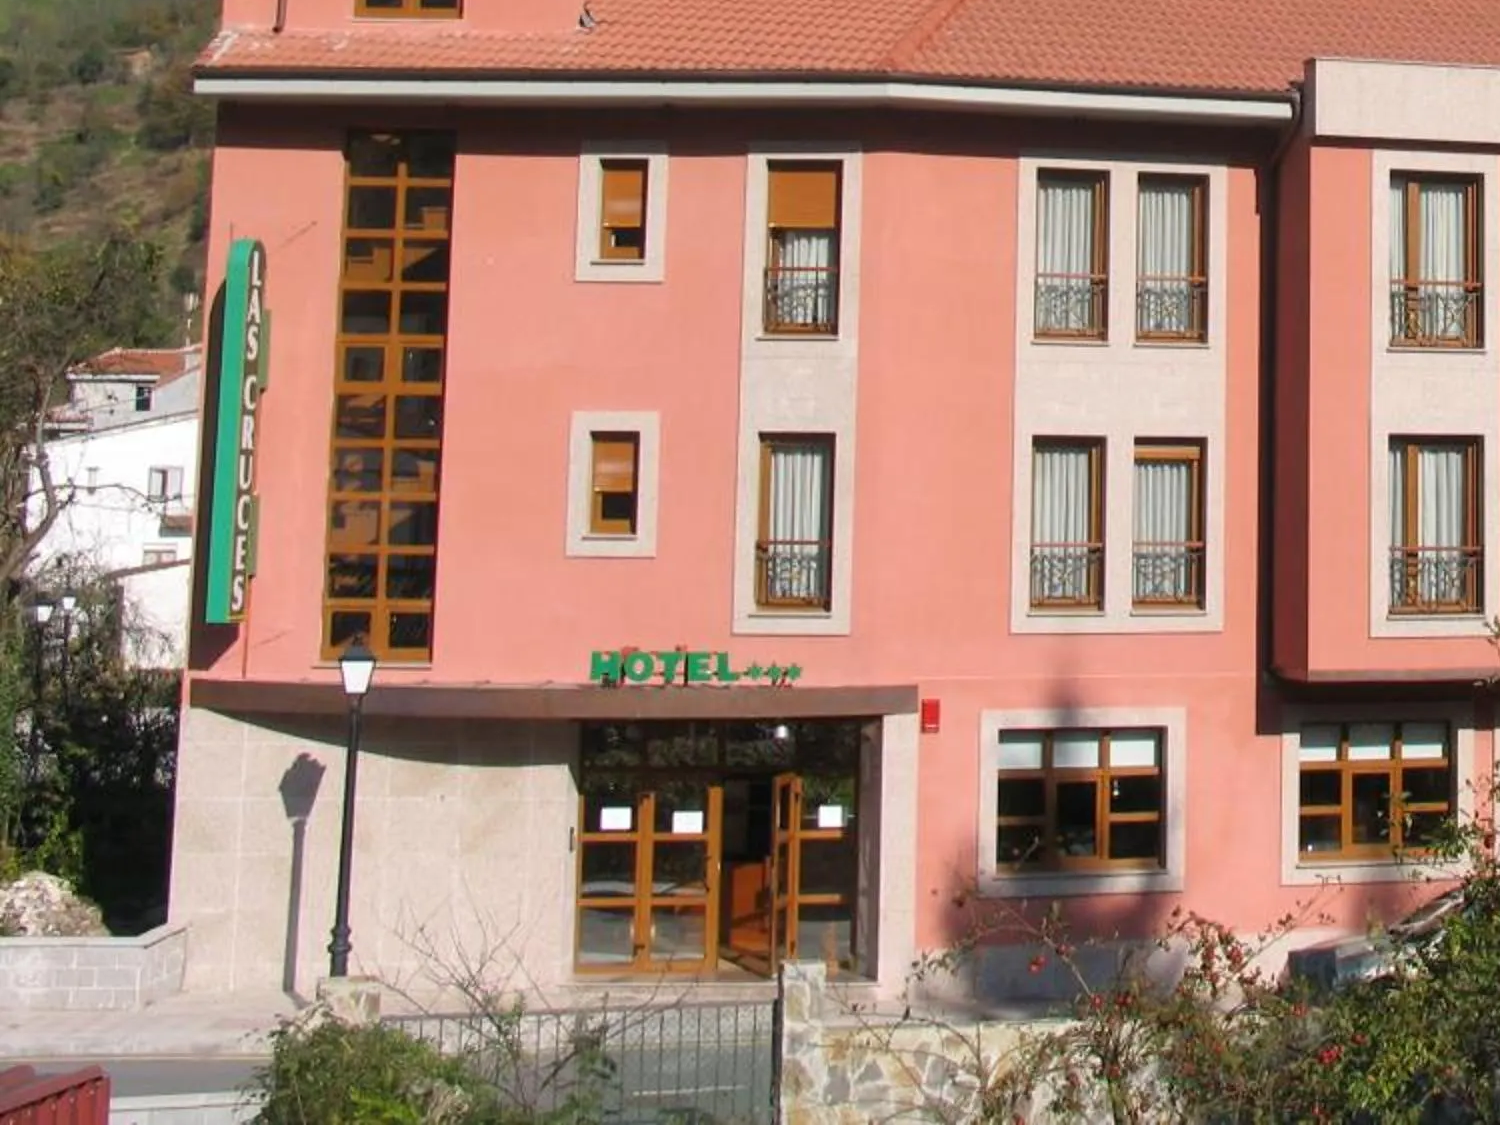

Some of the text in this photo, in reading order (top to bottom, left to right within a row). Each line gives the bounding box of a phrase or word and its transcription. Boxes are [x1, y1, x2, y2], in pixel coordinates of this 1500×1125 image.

[230, 251, 263, 611] LAS CRUCES
[589, 651, 740, 682] HOTEL
